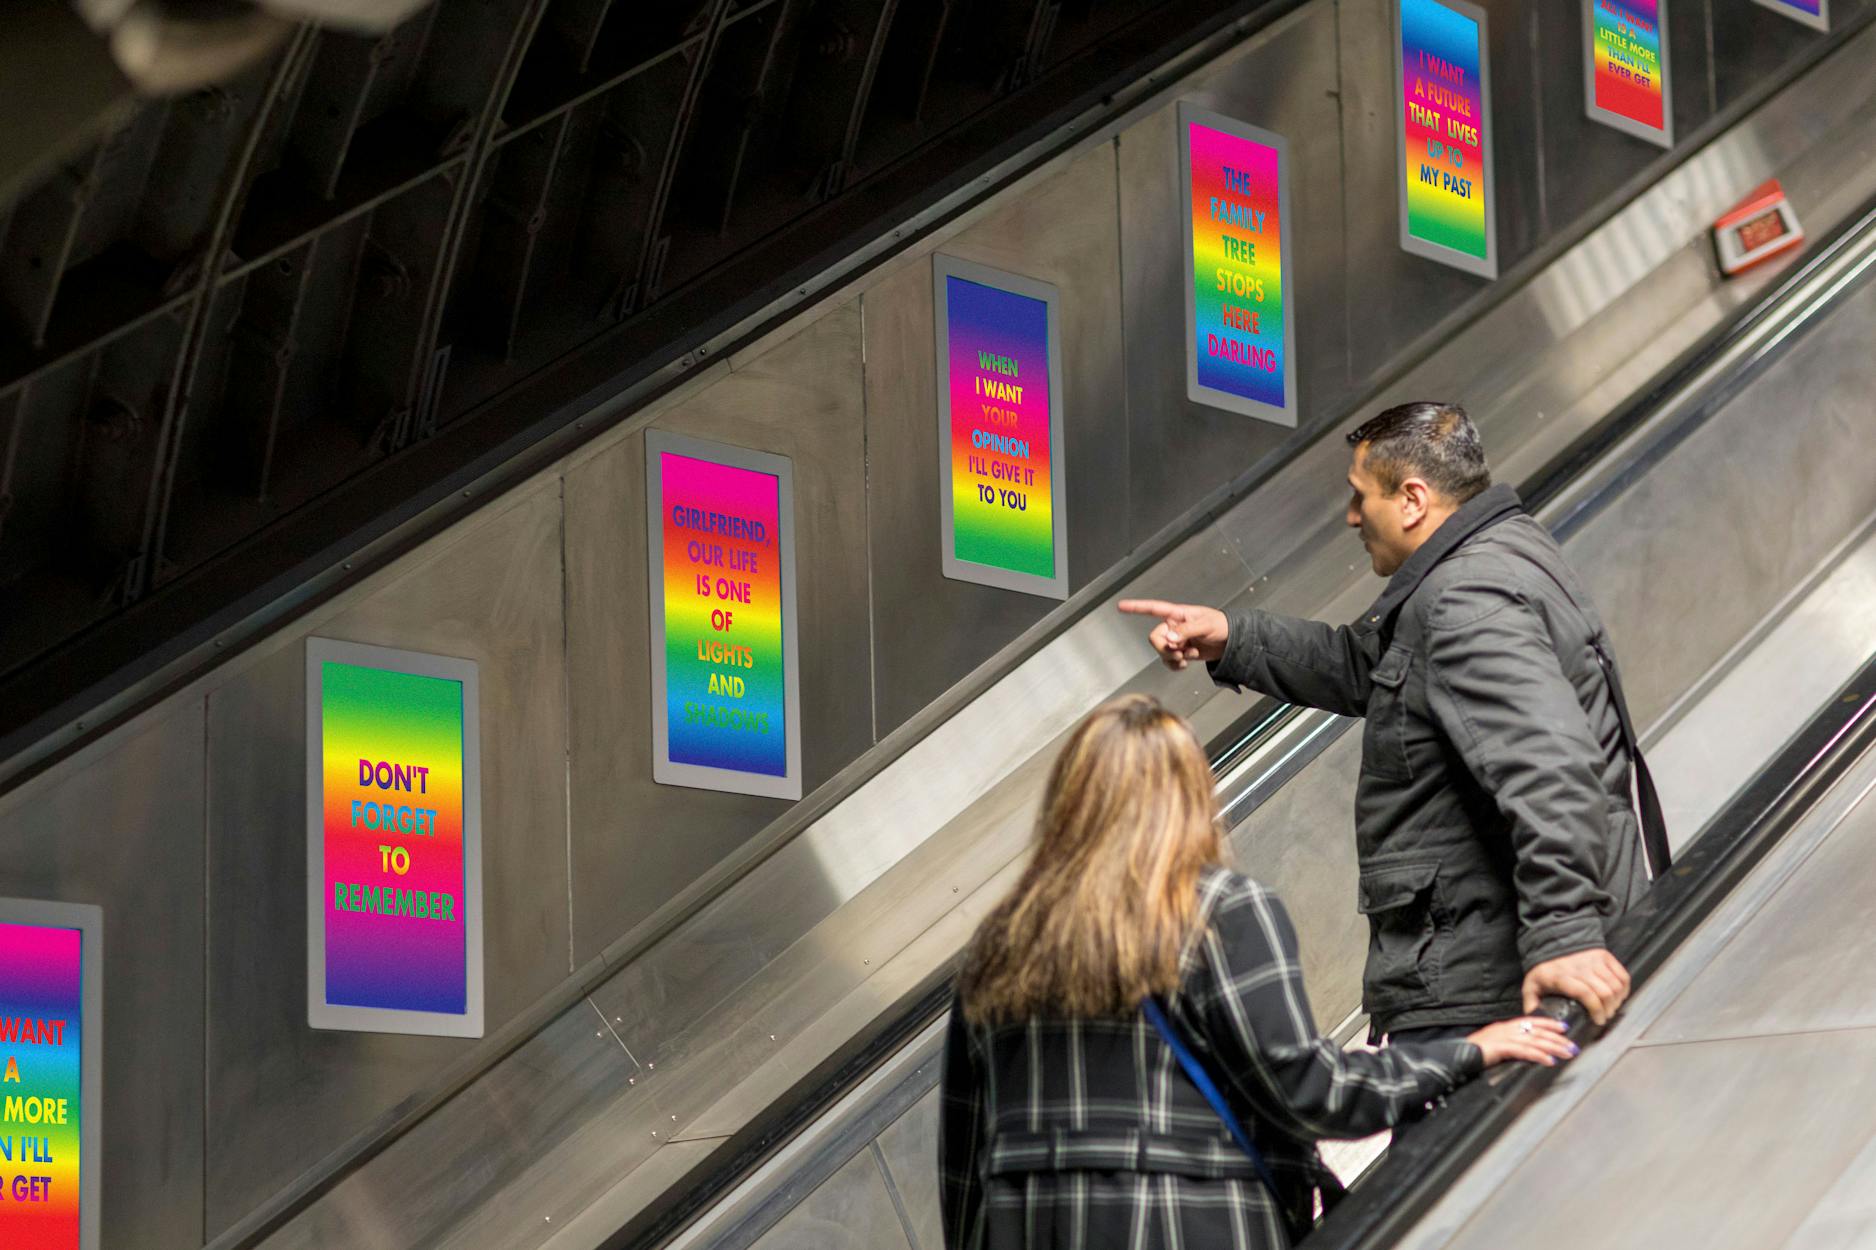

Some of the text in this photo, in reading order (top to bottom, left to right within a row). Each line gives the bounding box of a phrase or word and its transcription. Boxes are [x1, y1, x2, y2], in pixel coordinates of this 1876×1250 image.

[1600, 27, 1656, 64] LITTLE MORE
[1629, 28, 1637, 40] A
[1419, 49, 1465, 87] I WANT
[1608, 45, 1634, 67] THAN
[1608, 61, 1651, 89] EVER GET
[1415, 76, 1471, 118] A FUTURE
[1409, 101, 1479, 148] THAT LIVES
[1427, 138, 1463, 169] UP TO
[1222, 166, 1251, 197] THE
[1420, 163, 1472, 200] MY PAST
[1210, 196, 1266, 234] FAMILY
[1222, 234, 1256, 266] TREE
[1216, 267, 1264, 303] STOPS
[1223, 303, 1260, 335] HERE
[978, 350, 1019, 378] WHEN
[1207, 333, 1276, 374] DARLING
[975, 376, 1024, 405] I WANT
[981, 404, 1018, 428] YOUR
[971, 428, 1030, 459] OPINION
[969, 455, 1035, 487] I'LL GIVE IT
[977, 484, 1027, 512] TO YOU
[672, 504, 772, 548] GIRLFRIEND,
[687, 540, 758, 574] OUR LIFE
[696, 574, 751, 604] IS ONE
[711, 609, 733, 632] OF
[697, 639, 753, 669] LIGHTS
[708, 673, 745, 699] AND
[683, 701, 769, 735] SHADOWS
[359, 759, 429, 794] DON'T
[351, 799, 437, 837] FORGET
[379, 845, 410, 876] TO
[334, 882, 456, 921] REMEMBER
[0, 1016, 65, 1046] WANT
[4, 1056, 20, 1083] A
[4, 1096, 67, 1125] MORE
[21, 1136, 53, 1163] I'LL
[12, 1175, 52, 1203] GET
